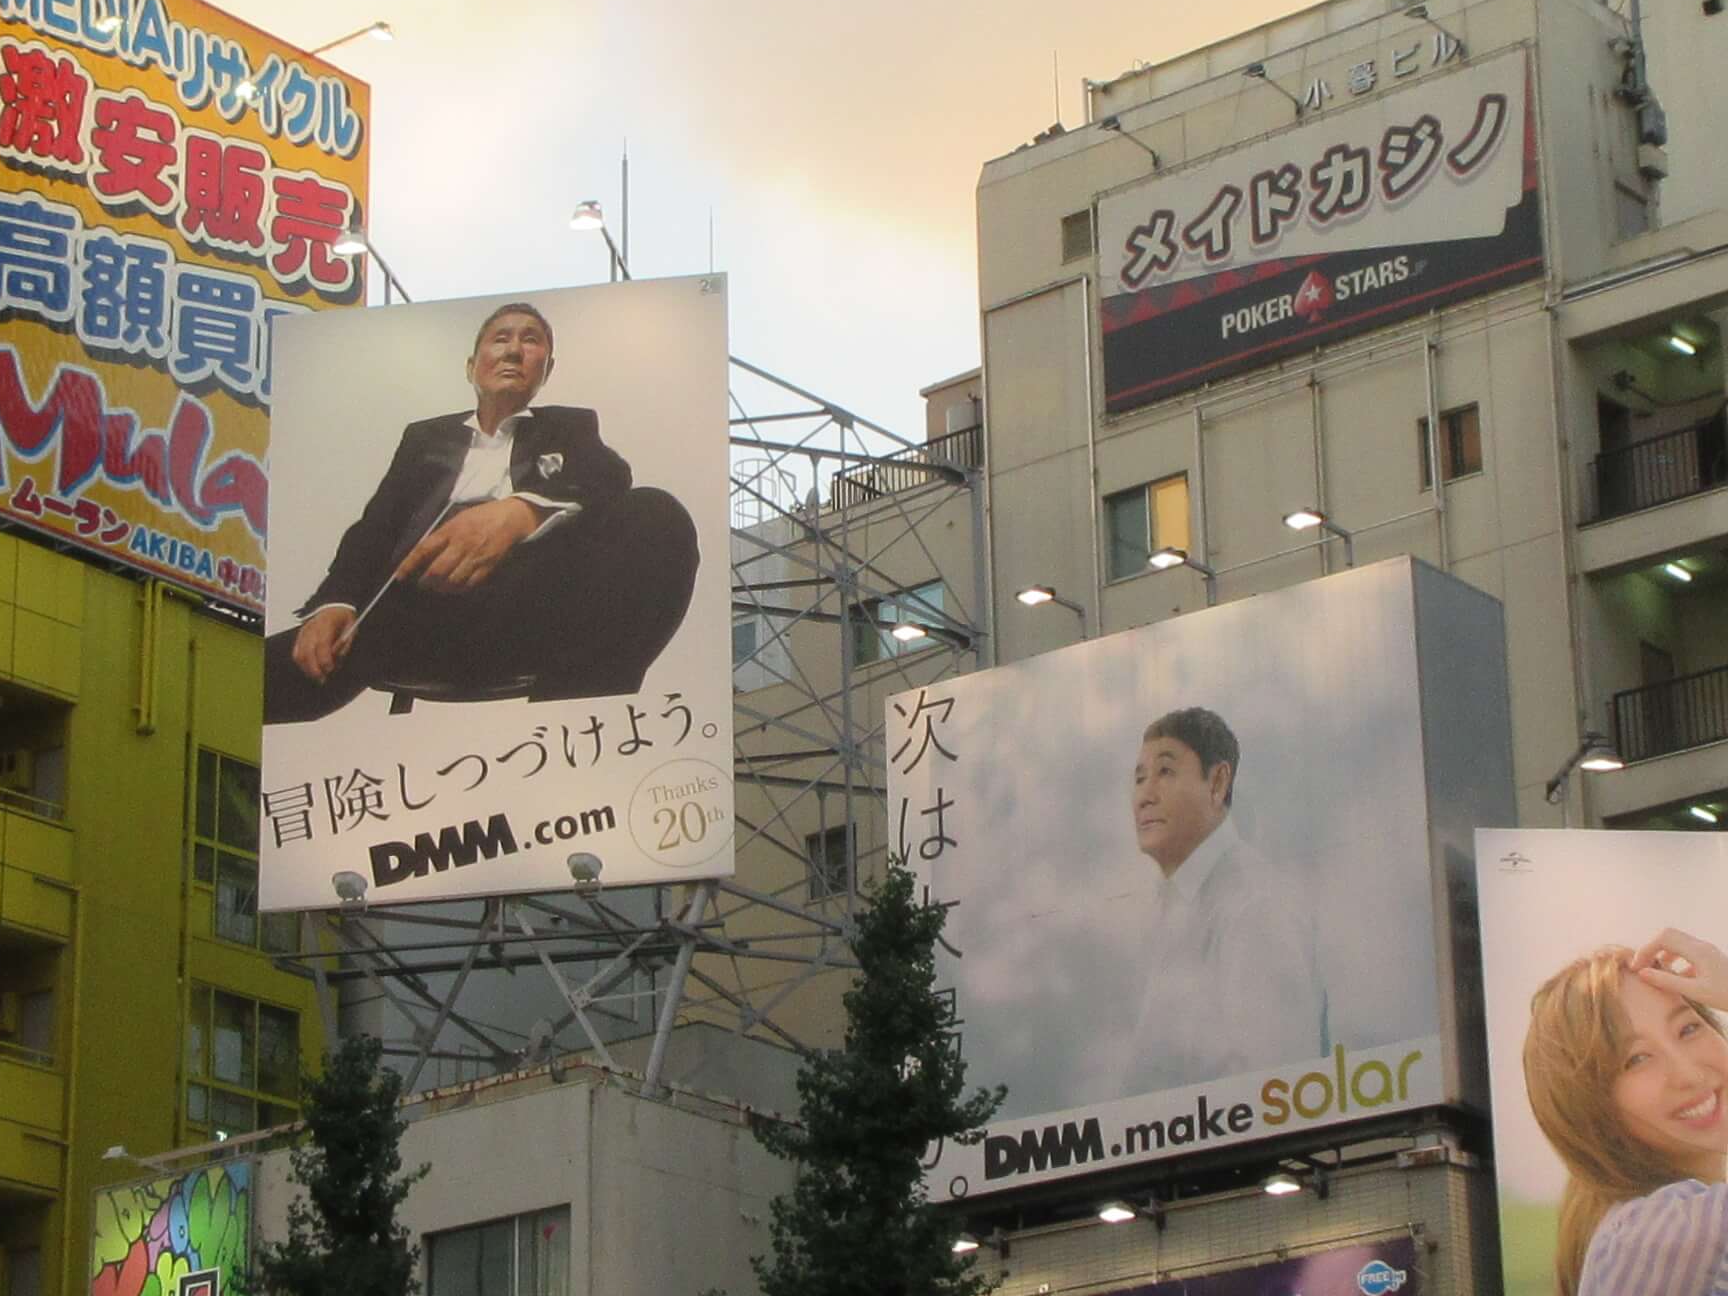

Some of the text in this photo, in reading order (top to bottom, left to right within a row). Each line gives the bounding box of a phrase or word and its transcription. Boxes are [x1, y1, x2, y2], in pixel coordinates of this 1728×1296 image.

[0, 42, 353, 288] 激安販売
[1124, 95, 1506, 286] メイドカジノ
[1221, 255, 1409, 339] POKER STARS
[11, 480, 129, 547] ムーラン
[131, 525, 214, 580] AKIBA
[262, 692, 721, 847] 冒険しつづけよう。
[648, 772, 720, 806] Thanks
[368, 802, 617, 887] DMM.com
[653, 805, 727, 852] 20th
[1260, 1045, 1423, 1127] solar
